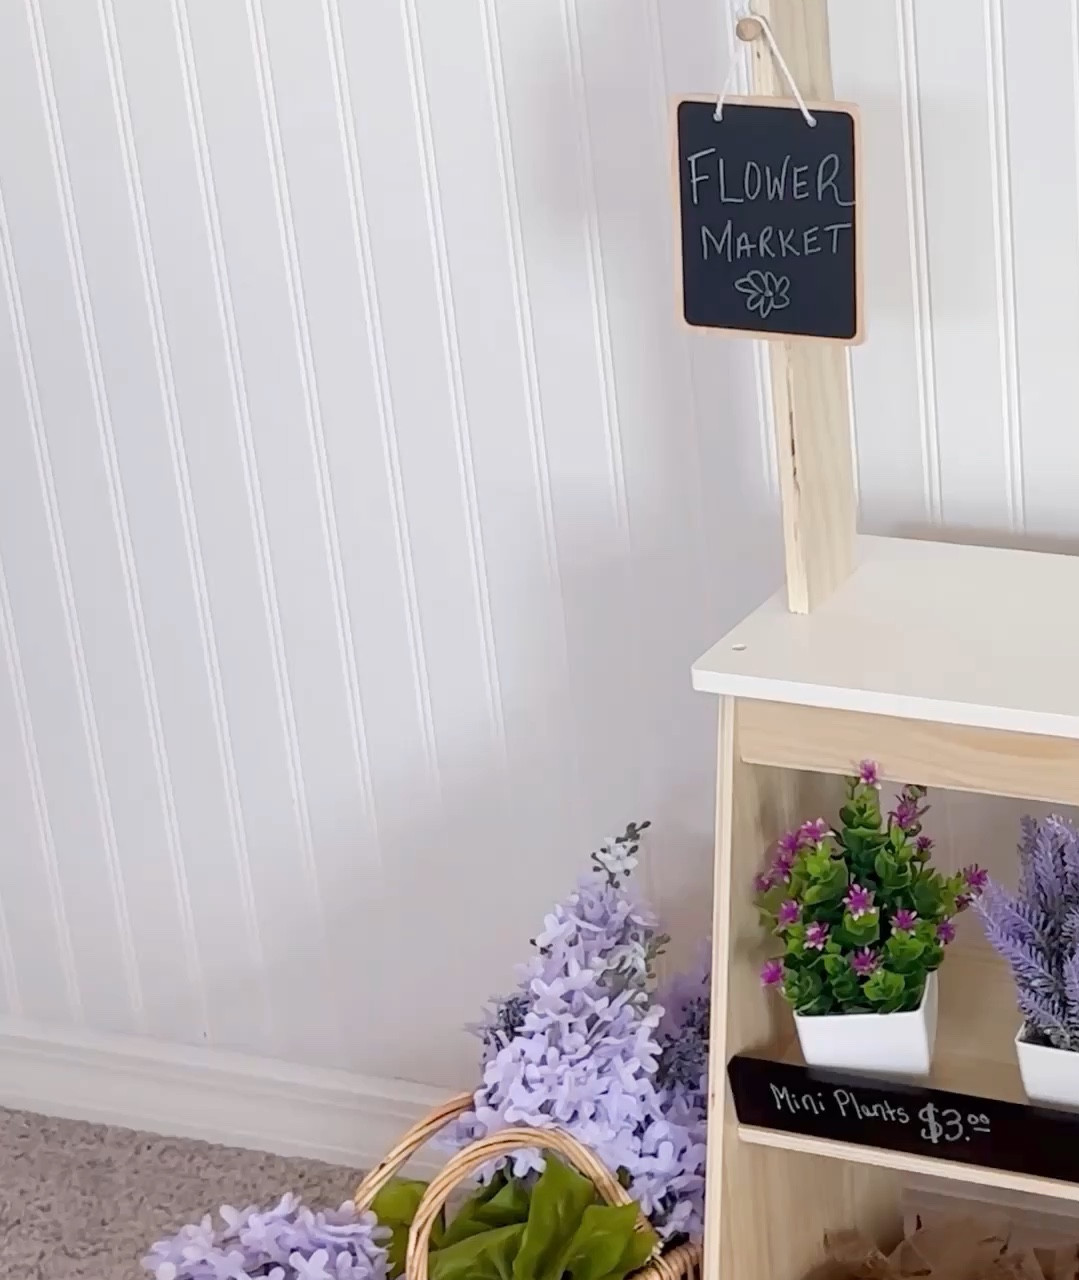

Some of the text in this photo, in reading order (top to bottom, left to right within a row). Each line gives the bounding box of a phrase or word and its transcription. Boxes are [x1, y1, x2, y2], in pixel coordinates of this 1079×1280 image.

[687, 148, 857, 207] FLOWER
[701, 219, 853, 263] MARKET
[769, 1082, 825, 1115] Mini
[834, 1088, 911, 1125] Plants
